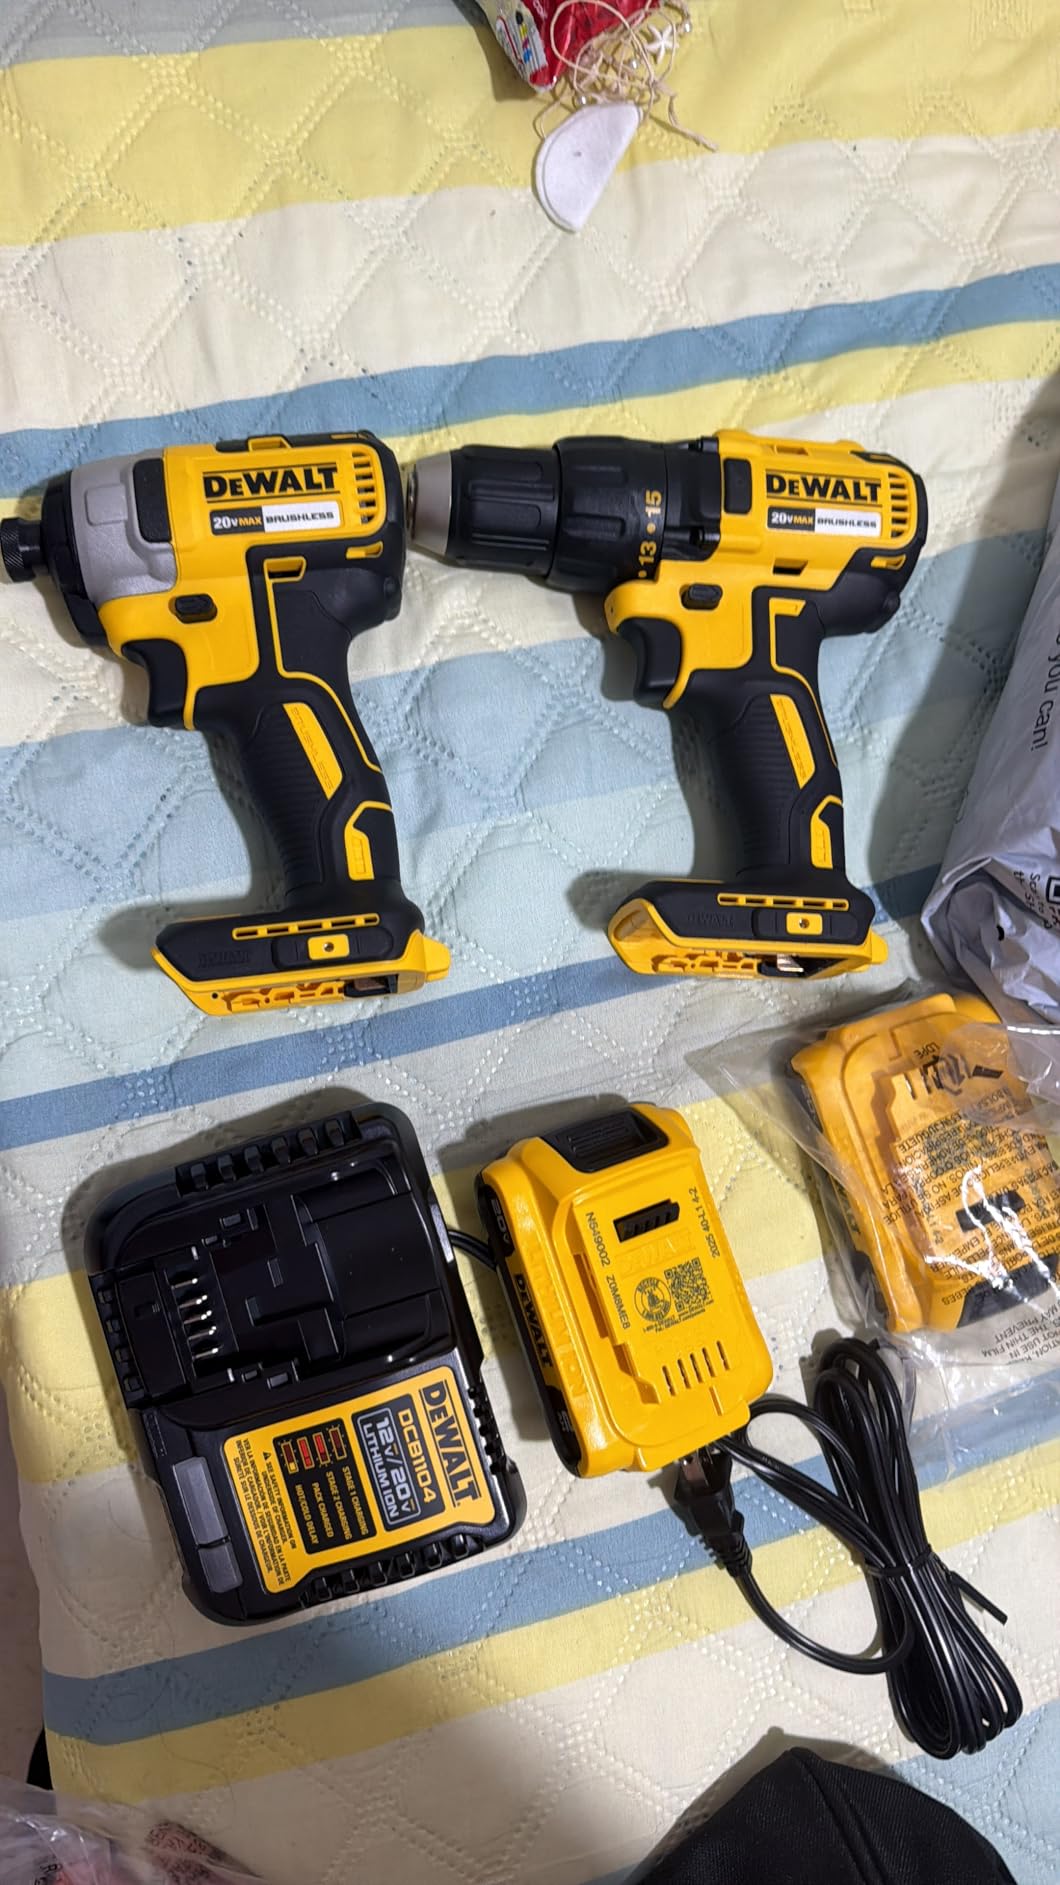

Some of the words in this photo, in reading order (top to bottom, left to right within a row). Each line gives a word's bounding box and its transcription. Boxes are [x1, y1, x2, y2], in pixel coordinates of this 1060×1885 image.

[265, 511, 334, 523] BRUSHLESS
[644, 489, 662, 518] 15
[816, 517, 876, 528] BRUSHLESS
[638, 539, 657, 566] 13
[1031, 699, 1054, 752] can!
[363, 1423, 389, 1487] LITHIUM
[383, 1489, 398, 1516] ION
[397, 1408, 436, 1502] DCB1104
[269, 1474, 280, 1495] SAFETY
[276, 1497, 293, 1538] INFORMATION
[311, 1482, 323, 1502] PACK
[318, 1502, 334, 1537] CHARGED
[325, 1470, 338, 1495] STAGE
[334, 1500, 352, 1539] CHARGING
[341, 1466, 354, 1490] STAGE
[351, 1496, 368, 1534] CHARGING
[306, 1521, 318, 1544] DELAY
